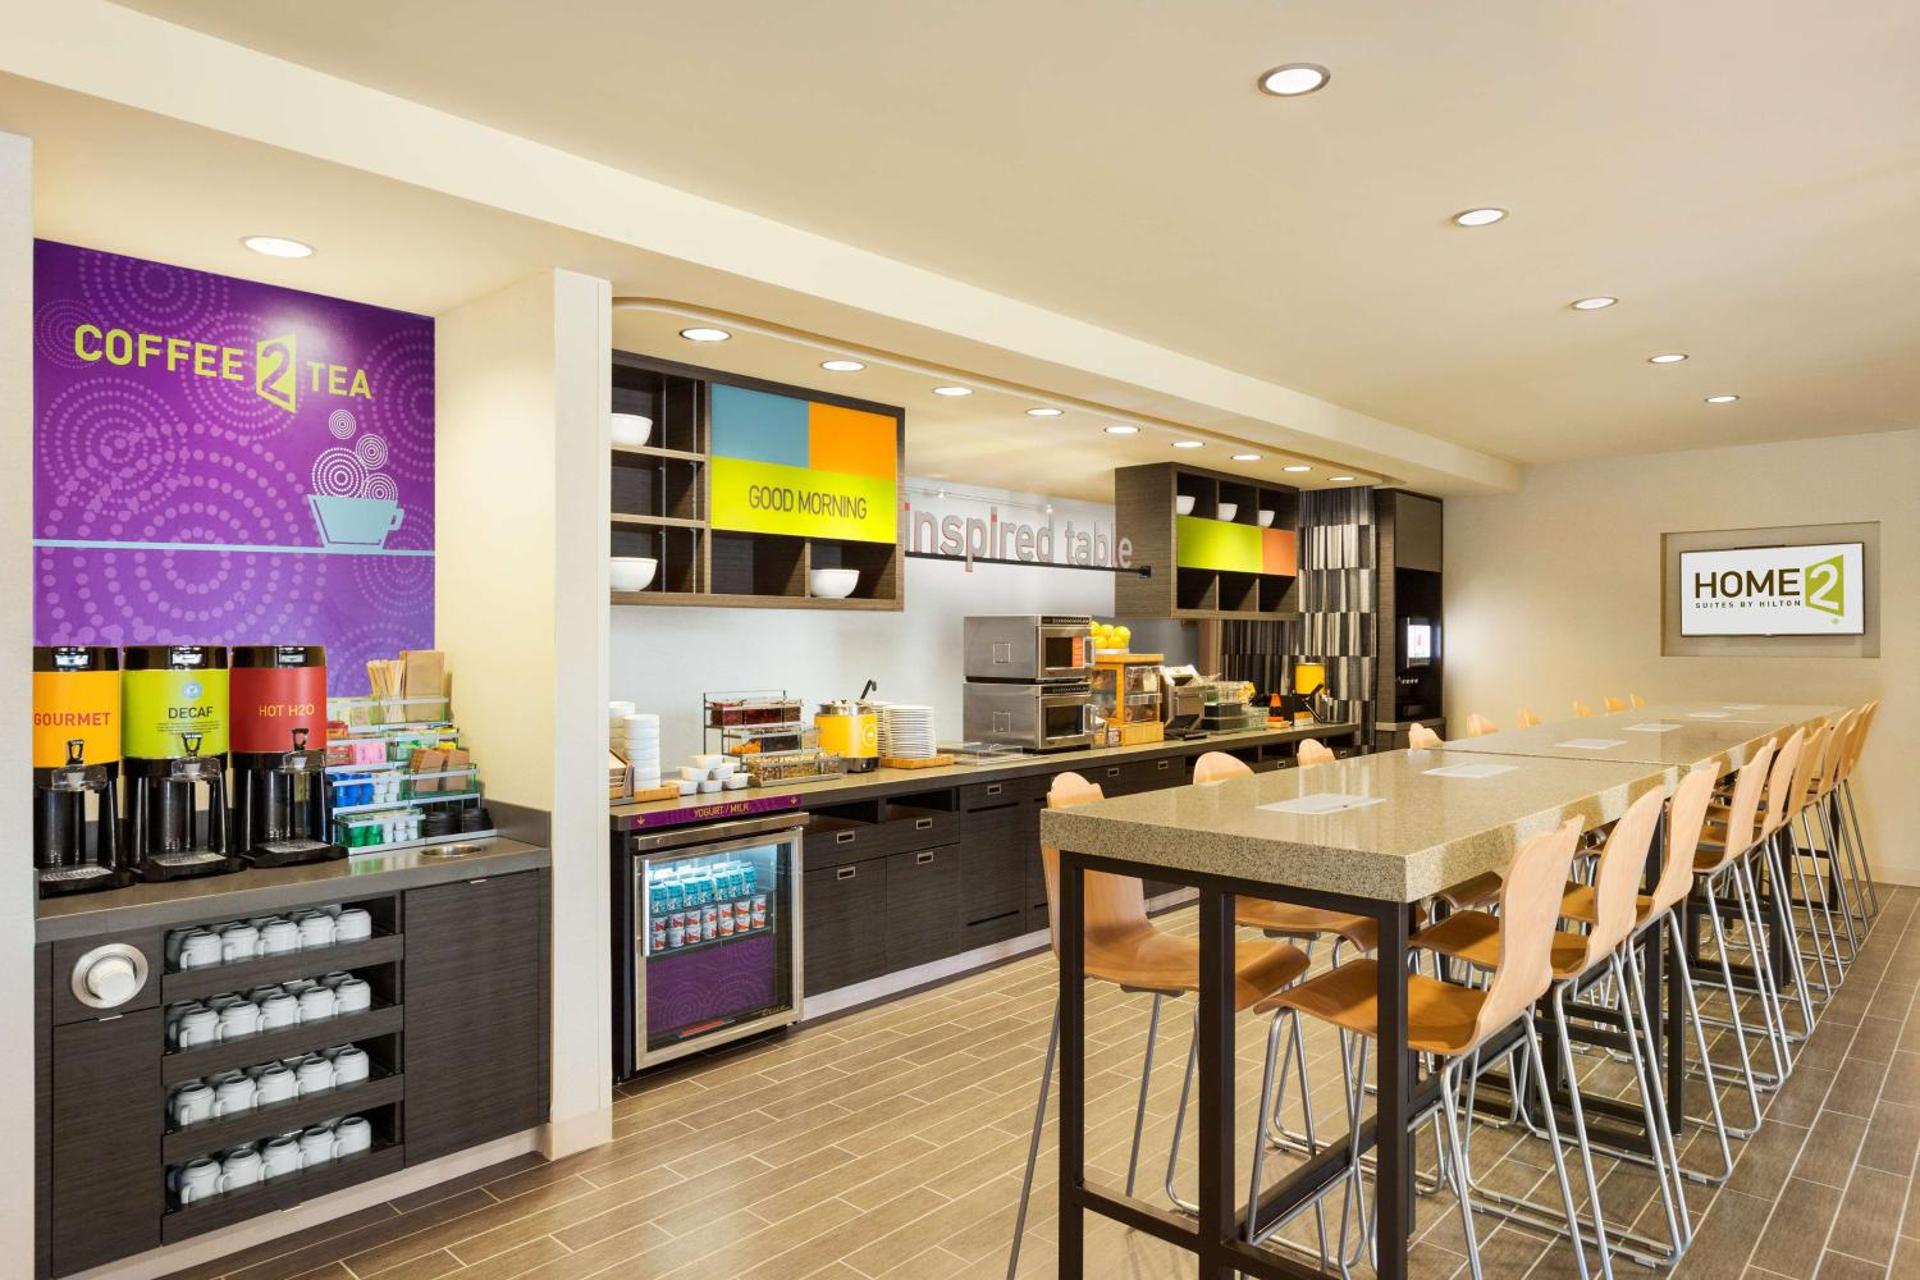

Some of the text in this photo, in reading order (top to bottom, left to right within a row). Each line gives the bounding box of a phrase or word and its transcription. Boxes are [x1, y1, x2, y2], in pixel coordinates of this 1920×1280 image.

[74, 324, 373, 401] COFFEE 2 TEA
[749, 484, 867, 520] GOOD MORNING
[904, 502, 1133, 573] inspired table
[1695, 568, 1800, 599] HOME
[1695, 601, 1735, 609] SUITES
[1759, 599, 1801, 607] HILTON
[168, 706, 213, 719] DECAF
[259, 704, 314, 717] HOT H2O
[33, 712, 111, 727] GOURMET
[694, 807, 725, 818] YOGURT
[730, 803, 751, 814] MILK
